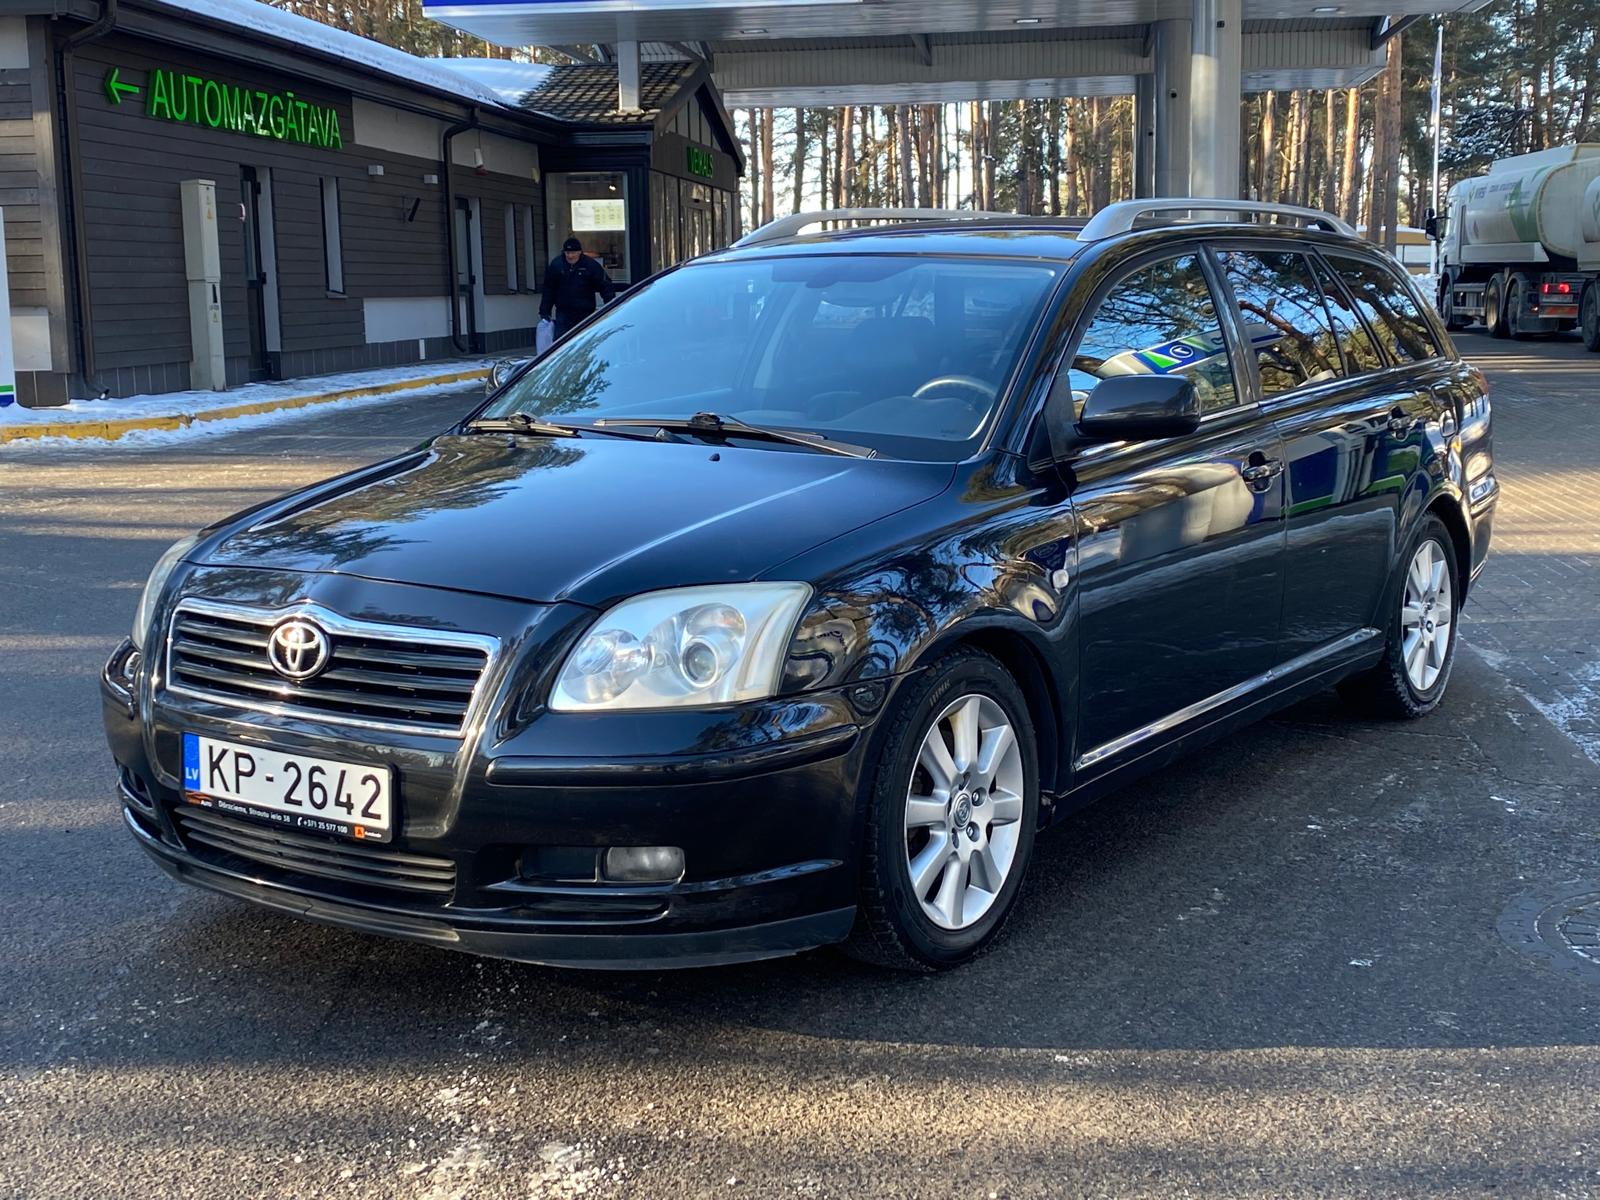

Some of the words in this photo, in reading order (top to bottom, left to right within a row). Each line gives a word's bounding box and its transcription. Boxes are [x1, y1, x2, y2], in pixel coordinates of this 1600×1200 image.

[150, 69, 343, 149] AUTOMAZGĀTAVA
[185, 767, 199, 780] LV
[208, 745, 382, 820] KP-2642
